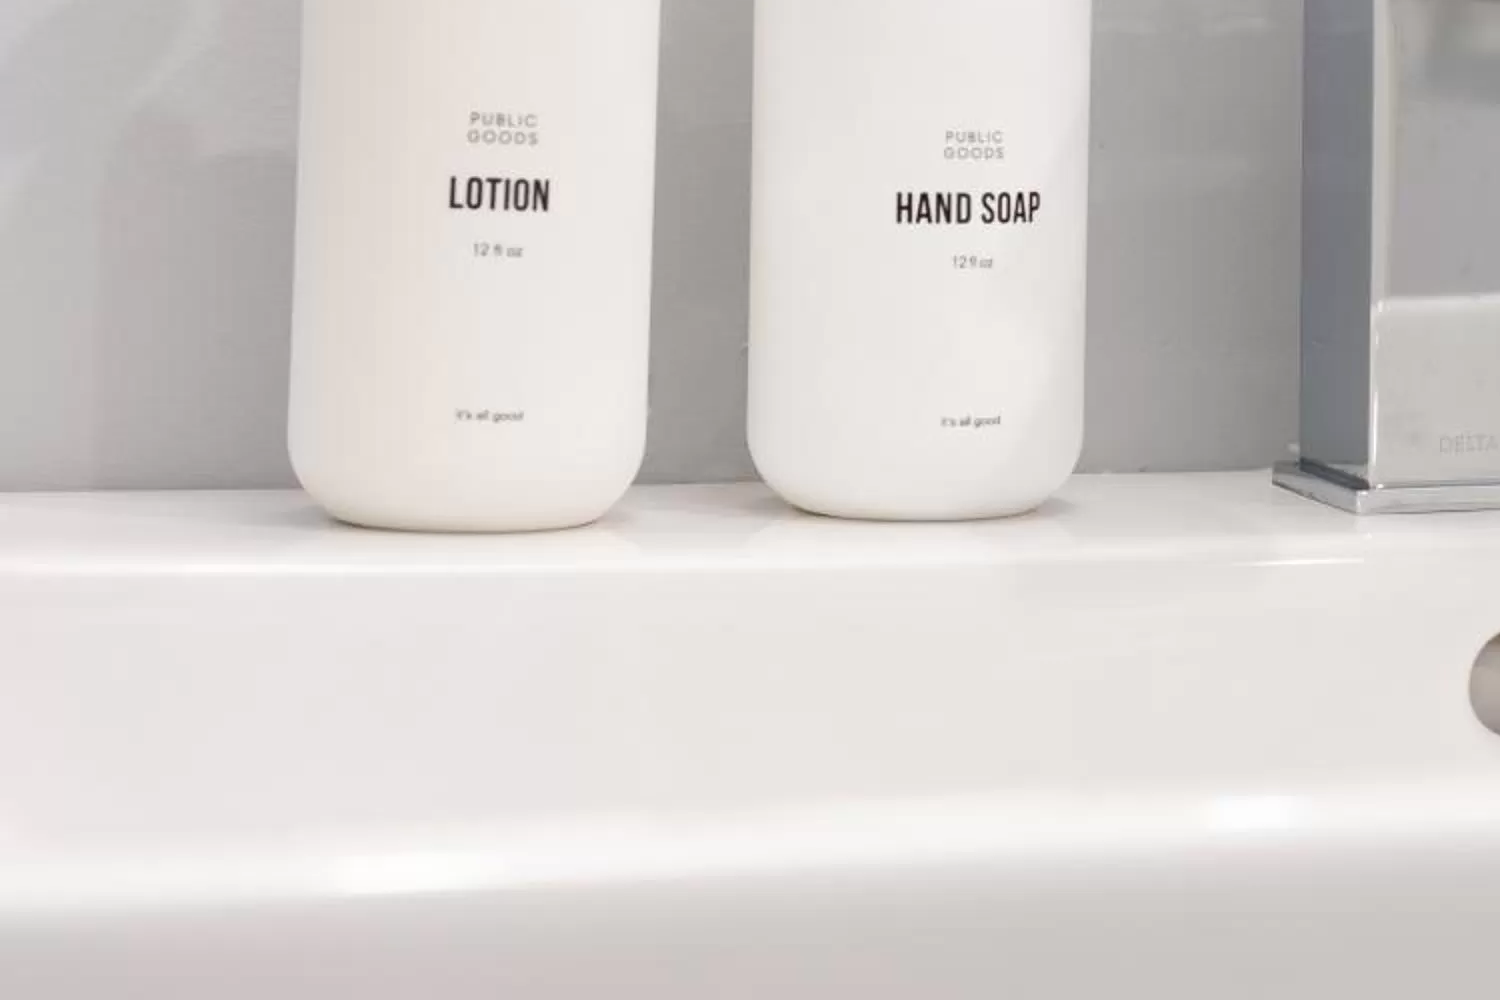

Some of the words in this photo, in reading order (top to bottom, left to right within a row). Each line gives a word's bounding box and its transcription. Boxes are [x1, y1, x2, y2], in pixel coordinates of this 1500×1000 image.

[469, 111, 538, 128] PUBLIC
[467, 129, 539, 145] GOODS
[945, 130, 1004, 144] PUBLIC
[943, 146, 1005, 160] GOODS
[449, 175, 550, 212] LOTION
[896, 191, 971, 225] HAND
[981, 191, 1041, 225] SOAP
[473, 242, 490, 257] 12
[953, 255, 967, 269] 12
[1439, 434, 1499, 454] DELTA
